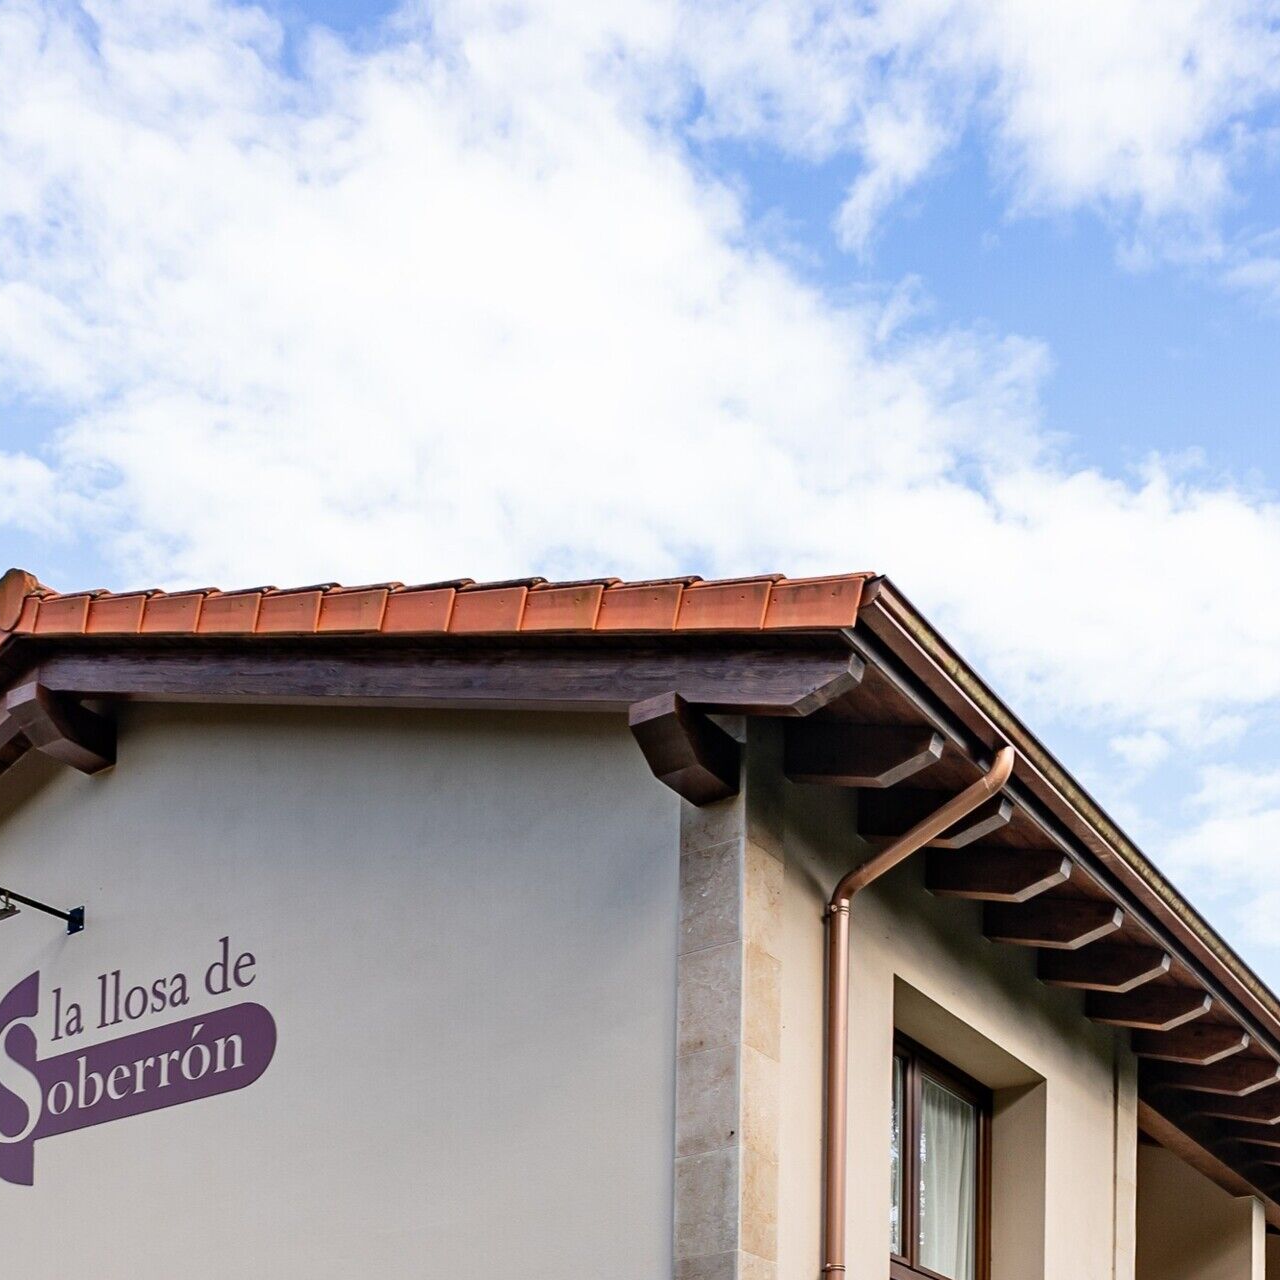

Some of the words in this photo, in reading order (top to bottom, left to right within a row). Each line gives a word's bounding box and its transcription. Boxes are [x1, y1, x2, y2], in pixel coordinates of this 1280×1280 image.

[51, 988, 84, 1041] la
[96, 969, 190, 1029] llosa
[204, 936, 257, 995] de
